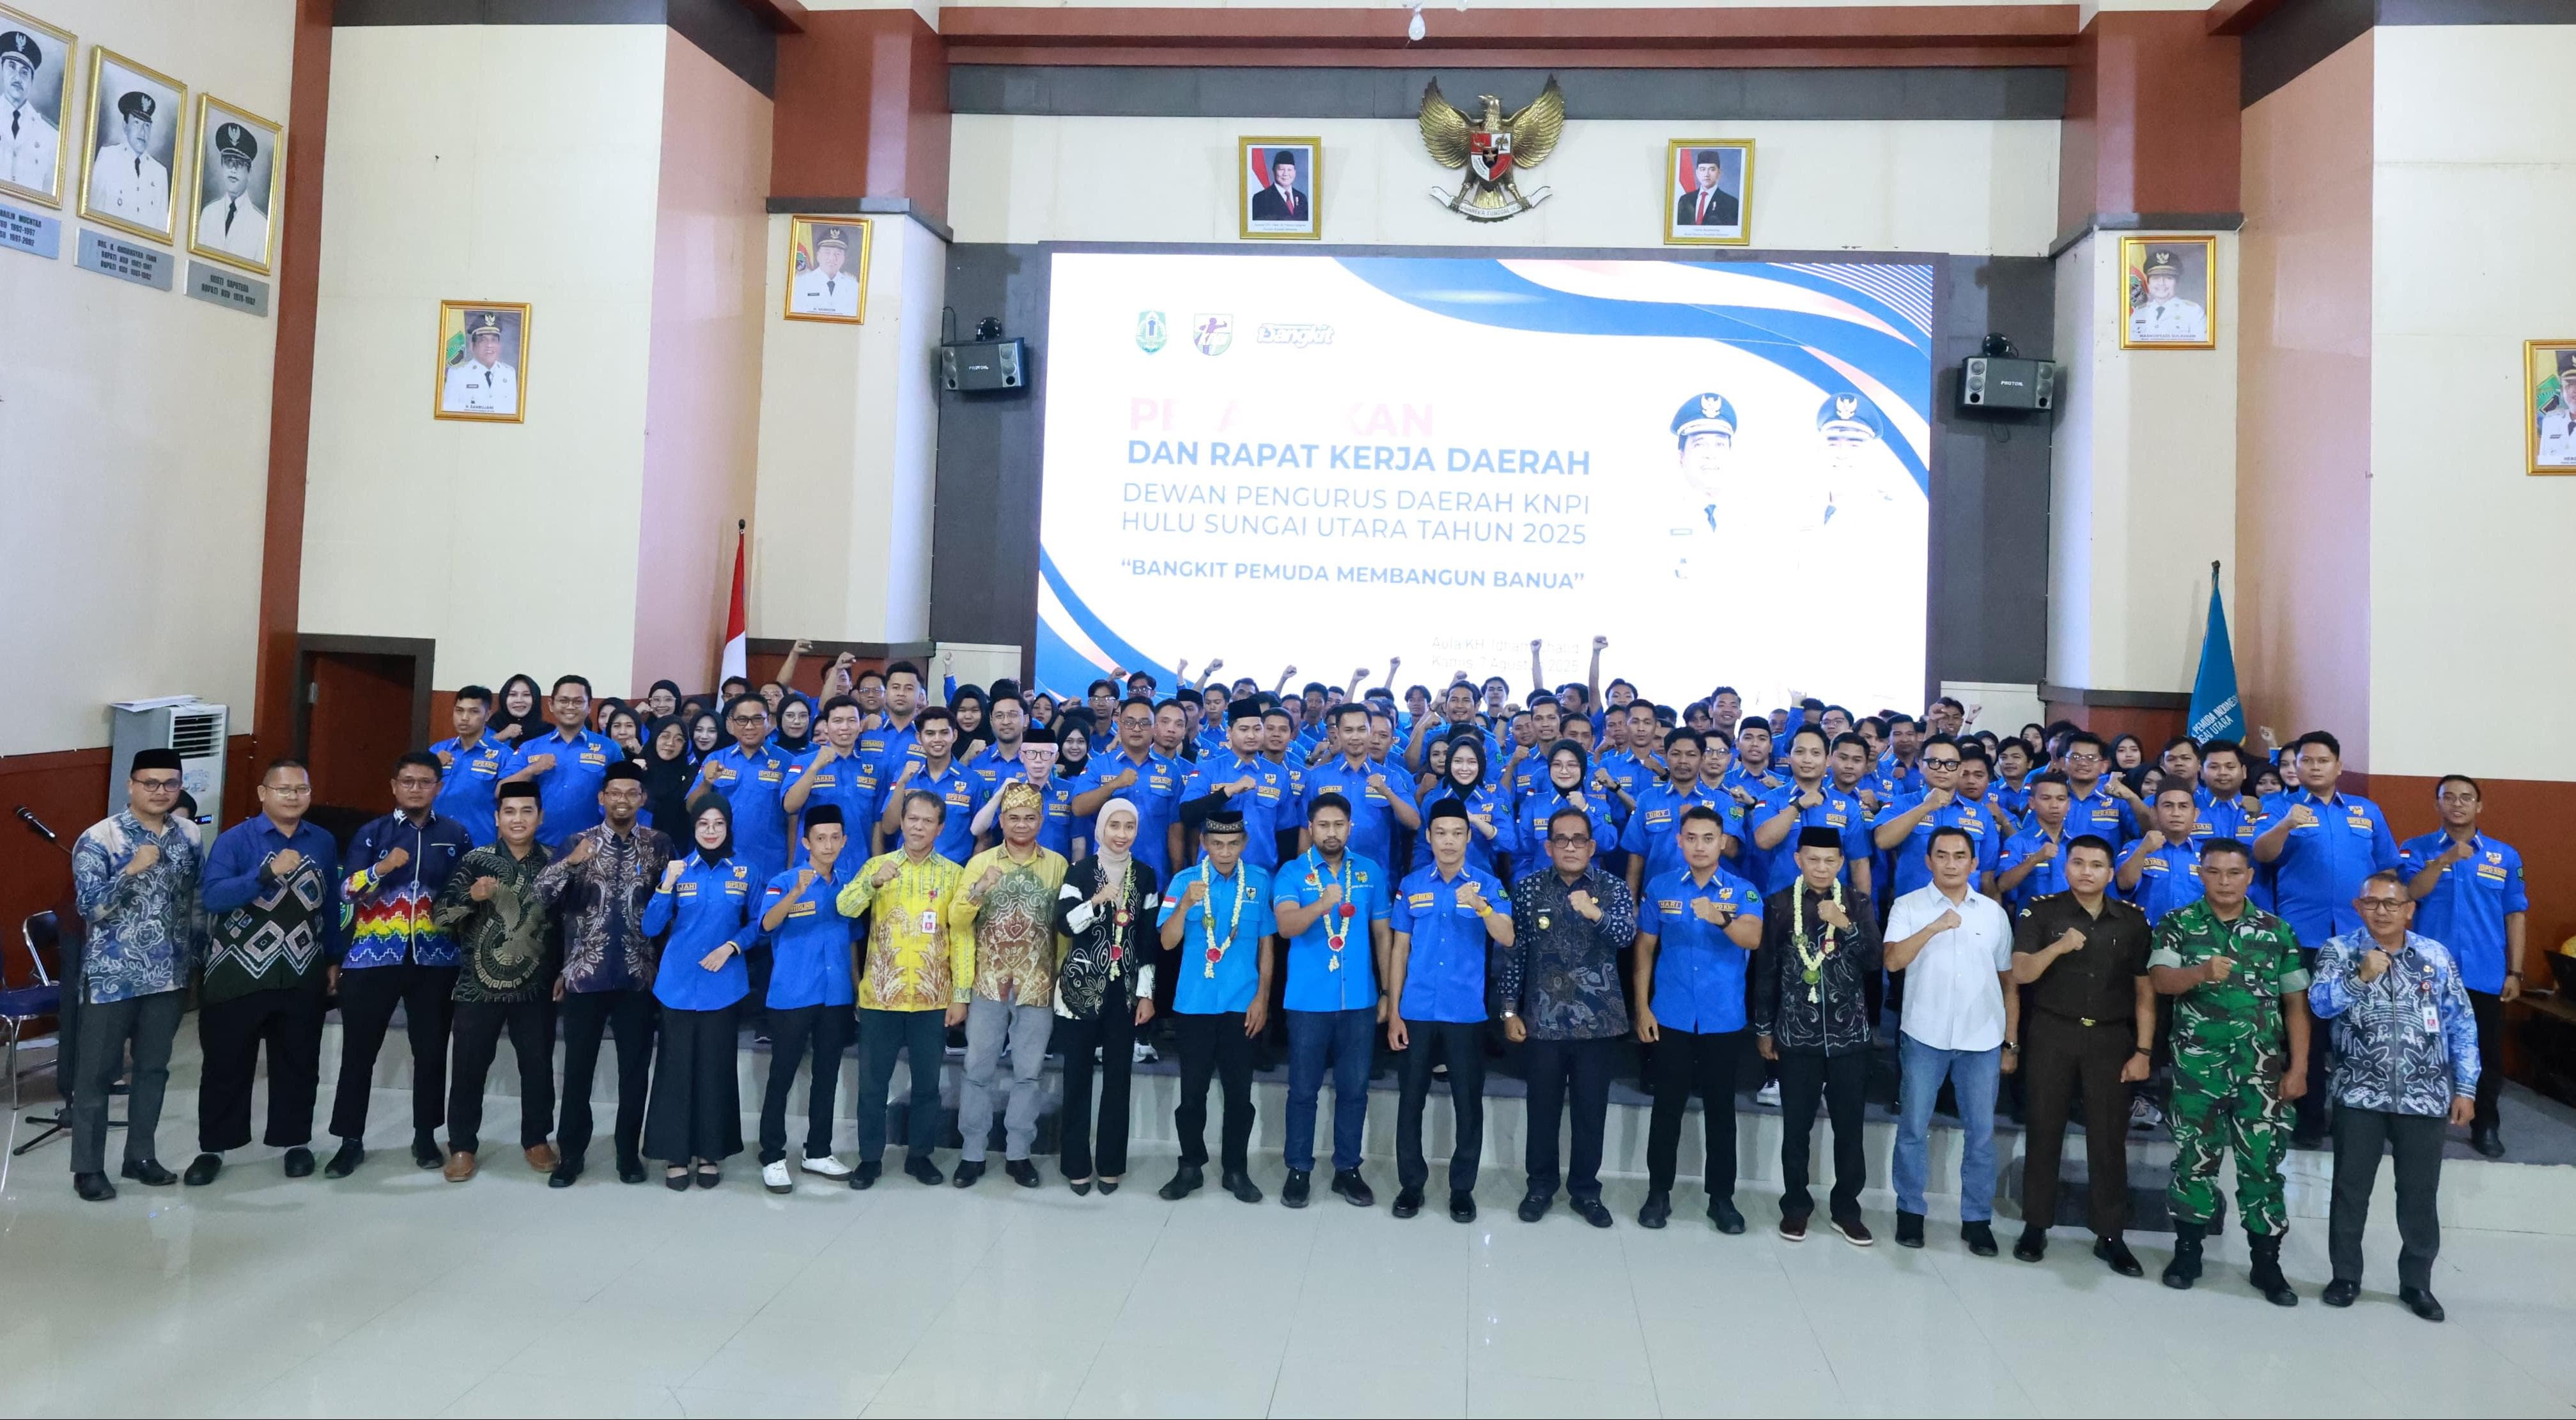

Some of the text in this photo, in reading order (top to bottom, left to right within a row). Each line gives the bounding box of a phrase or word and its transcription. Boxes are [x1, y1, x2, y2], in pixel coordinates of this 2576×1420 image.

[1129, 440, 1589, 475] DAN RAPAT KERJA DAERAH
[1124, 483, 1588, 514] DEWAN PENGURUS DAERAH KNPI
[1123, 512, 1585, 544] HULU SUNGAI UTARA TAHUN 2025
[1235, 563, 1328, 581] PEMUDA
[1337, 566, 1485, 586] MEMBANGUN
[1549, 659, 1579, 673] 2025
[2192, 712, 2218, 735] PEMUDA
[2209, 715, 2234, 735] UTARA
